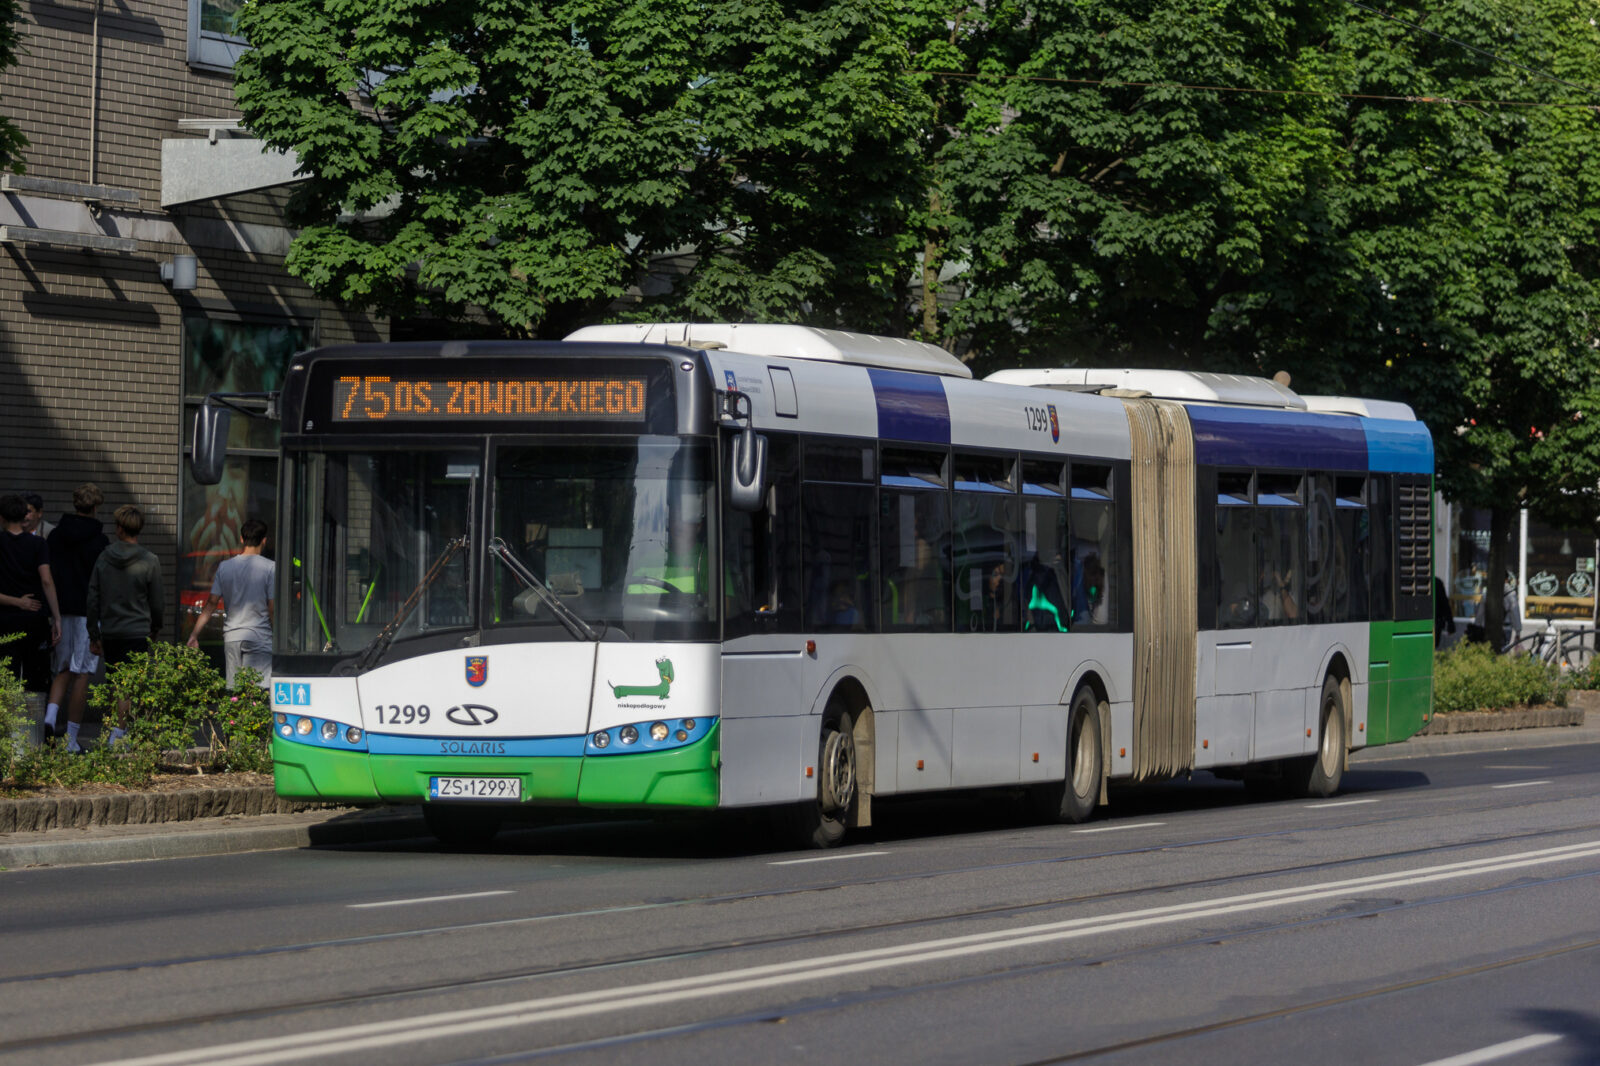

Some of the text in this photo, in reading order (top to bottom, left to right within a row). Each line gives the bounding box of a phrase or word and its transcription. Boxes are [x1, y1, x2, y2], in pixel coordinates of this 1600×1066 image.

[340, 376, 644, 418] 75 OS. ZAWADZKIEGO
[1025, 406, 1048, 432] 1299
[375, 704, 430, 724] 1299
[440, 742, 506, 754] SOLARIS
